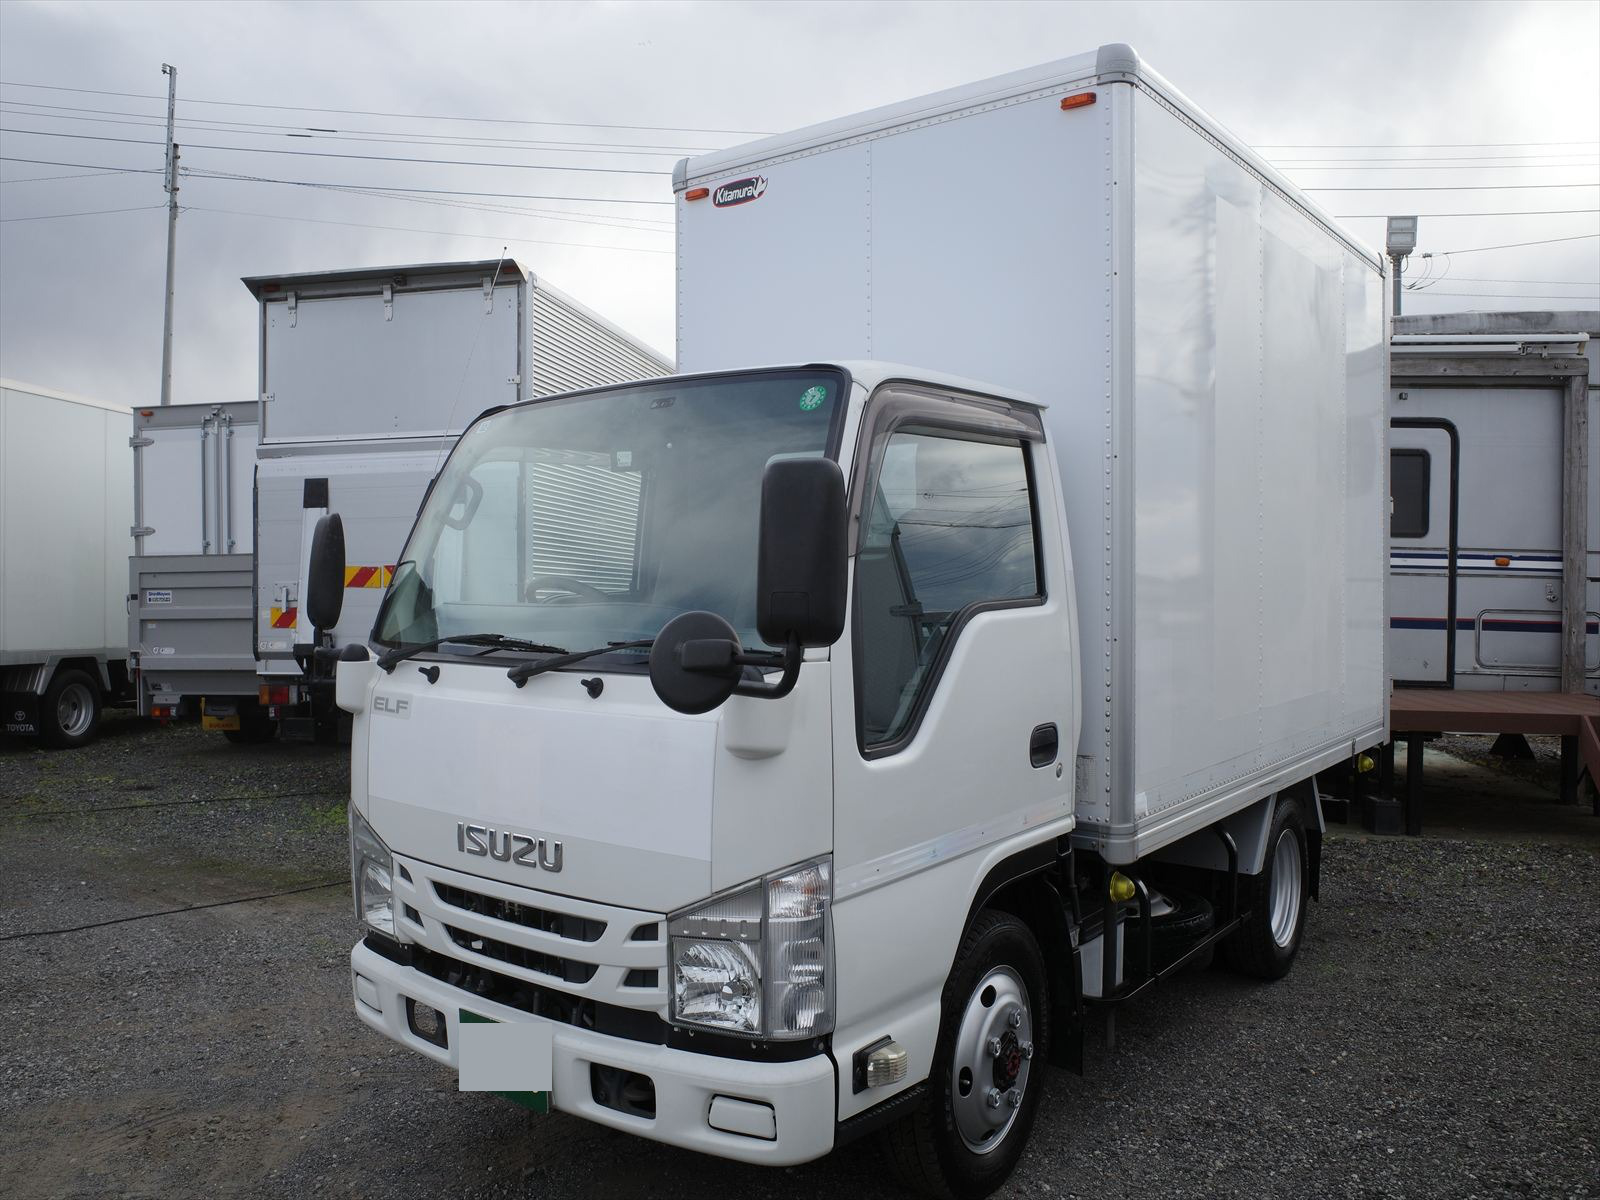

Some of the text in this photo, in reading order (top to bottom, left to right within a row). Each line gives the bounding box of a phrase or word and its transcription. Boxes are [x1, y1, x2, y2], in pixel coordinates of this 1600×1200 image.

[715, 186, 753, 205] Kitamura
[373, 695, 409, 714] ELF
[6, 723, 35, 732] TOYOTA
[456, 820, 563, 874] ISUZU
